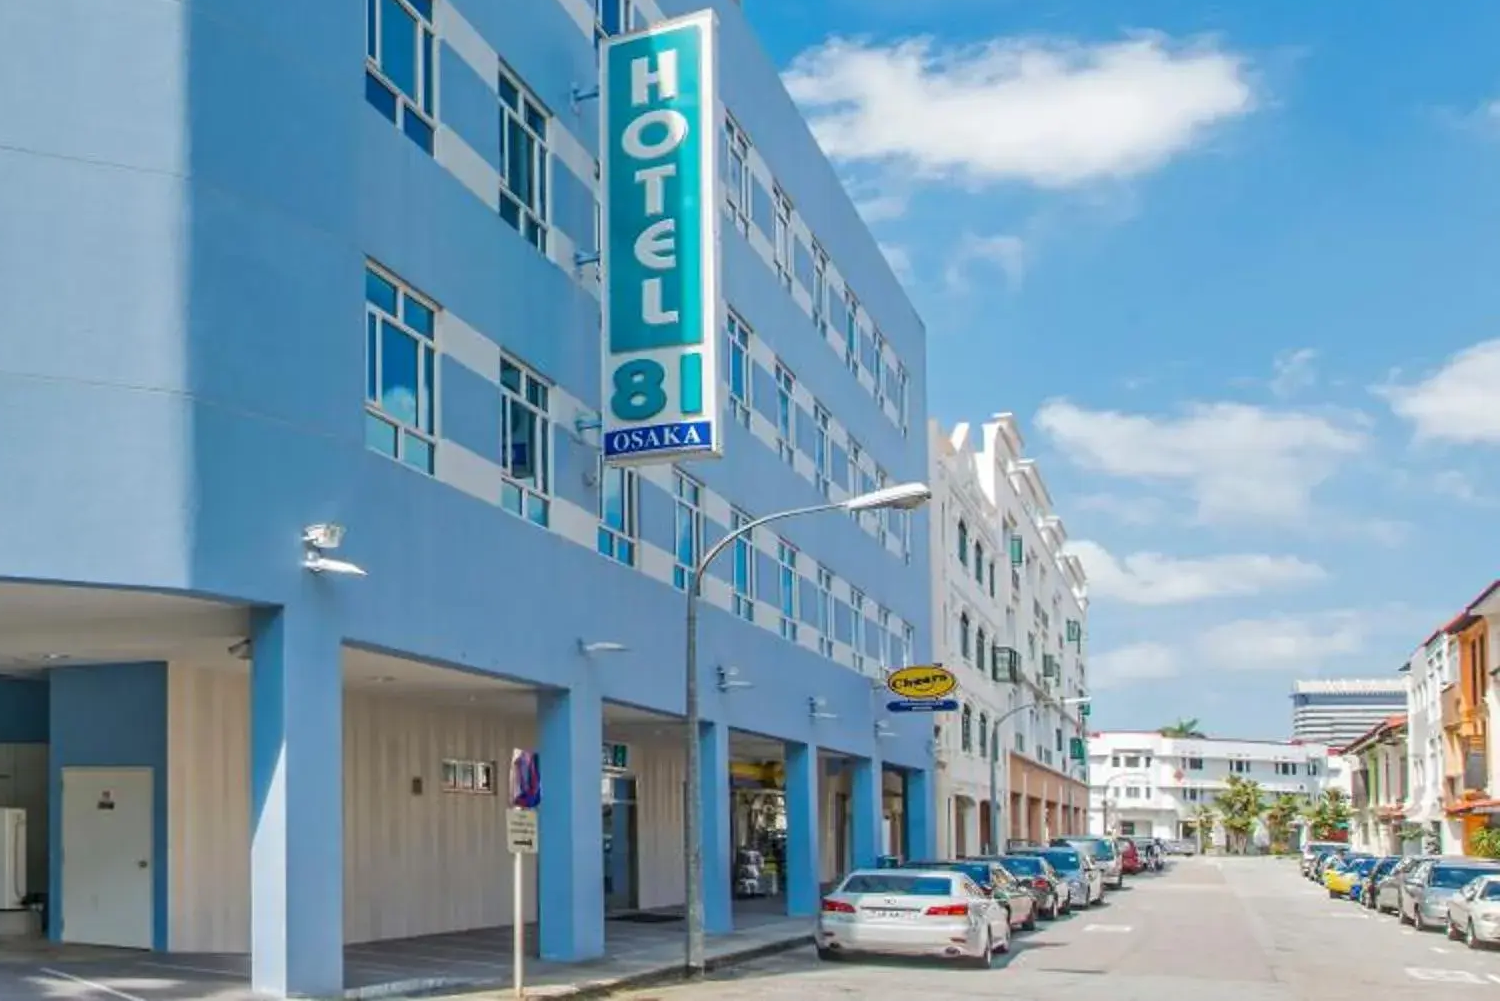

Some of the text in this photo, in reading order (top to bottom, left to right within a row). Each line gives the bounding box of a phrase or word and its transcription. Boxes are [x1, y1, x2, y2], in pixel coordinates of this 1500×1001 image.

[621, 49, 688, 324] HOTEL
[611, 353, 702, 420] 81
[613, 425, 701, 451] OSAKA
